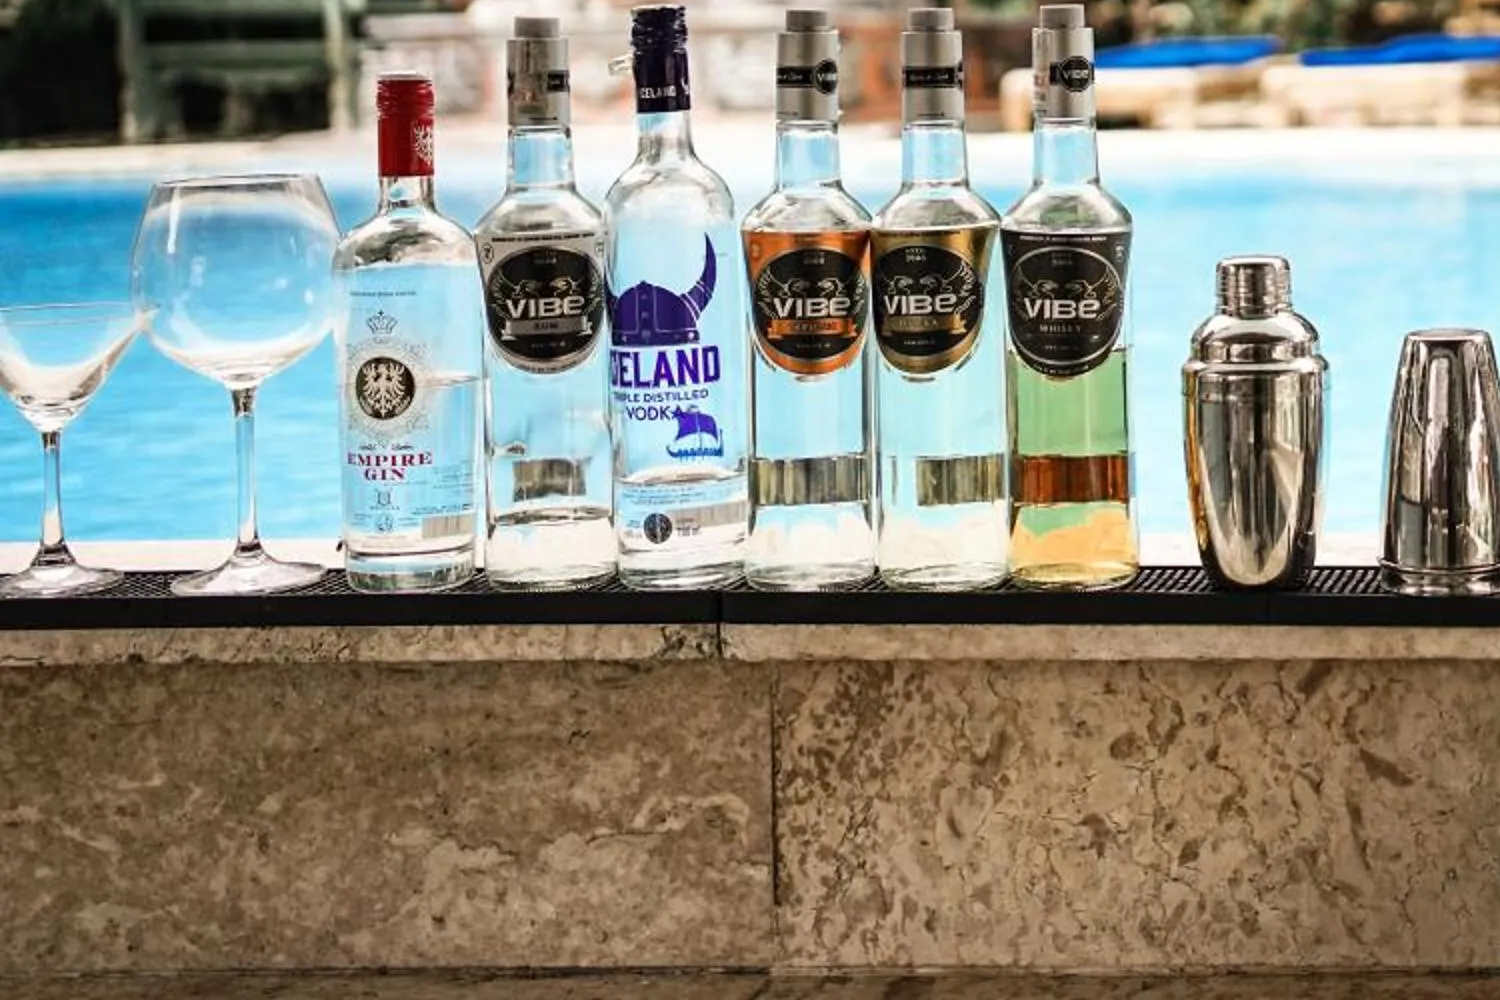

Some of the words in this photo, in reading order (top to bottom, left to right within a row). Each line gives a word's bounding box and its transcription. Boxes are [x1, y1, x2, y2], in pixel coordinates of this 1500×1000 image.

[506, 295, 585, 319] VIBE
[773, 297, 851, 318] VIBE
[884, 293, 957, 316] VIBE
[1023, 297, 1101, 319] VIBE
[643, 388, 709, 403] DISTILLED
[347, 451, 433, 467] EMPIRE
[364, 467, 406, 481] GIN
